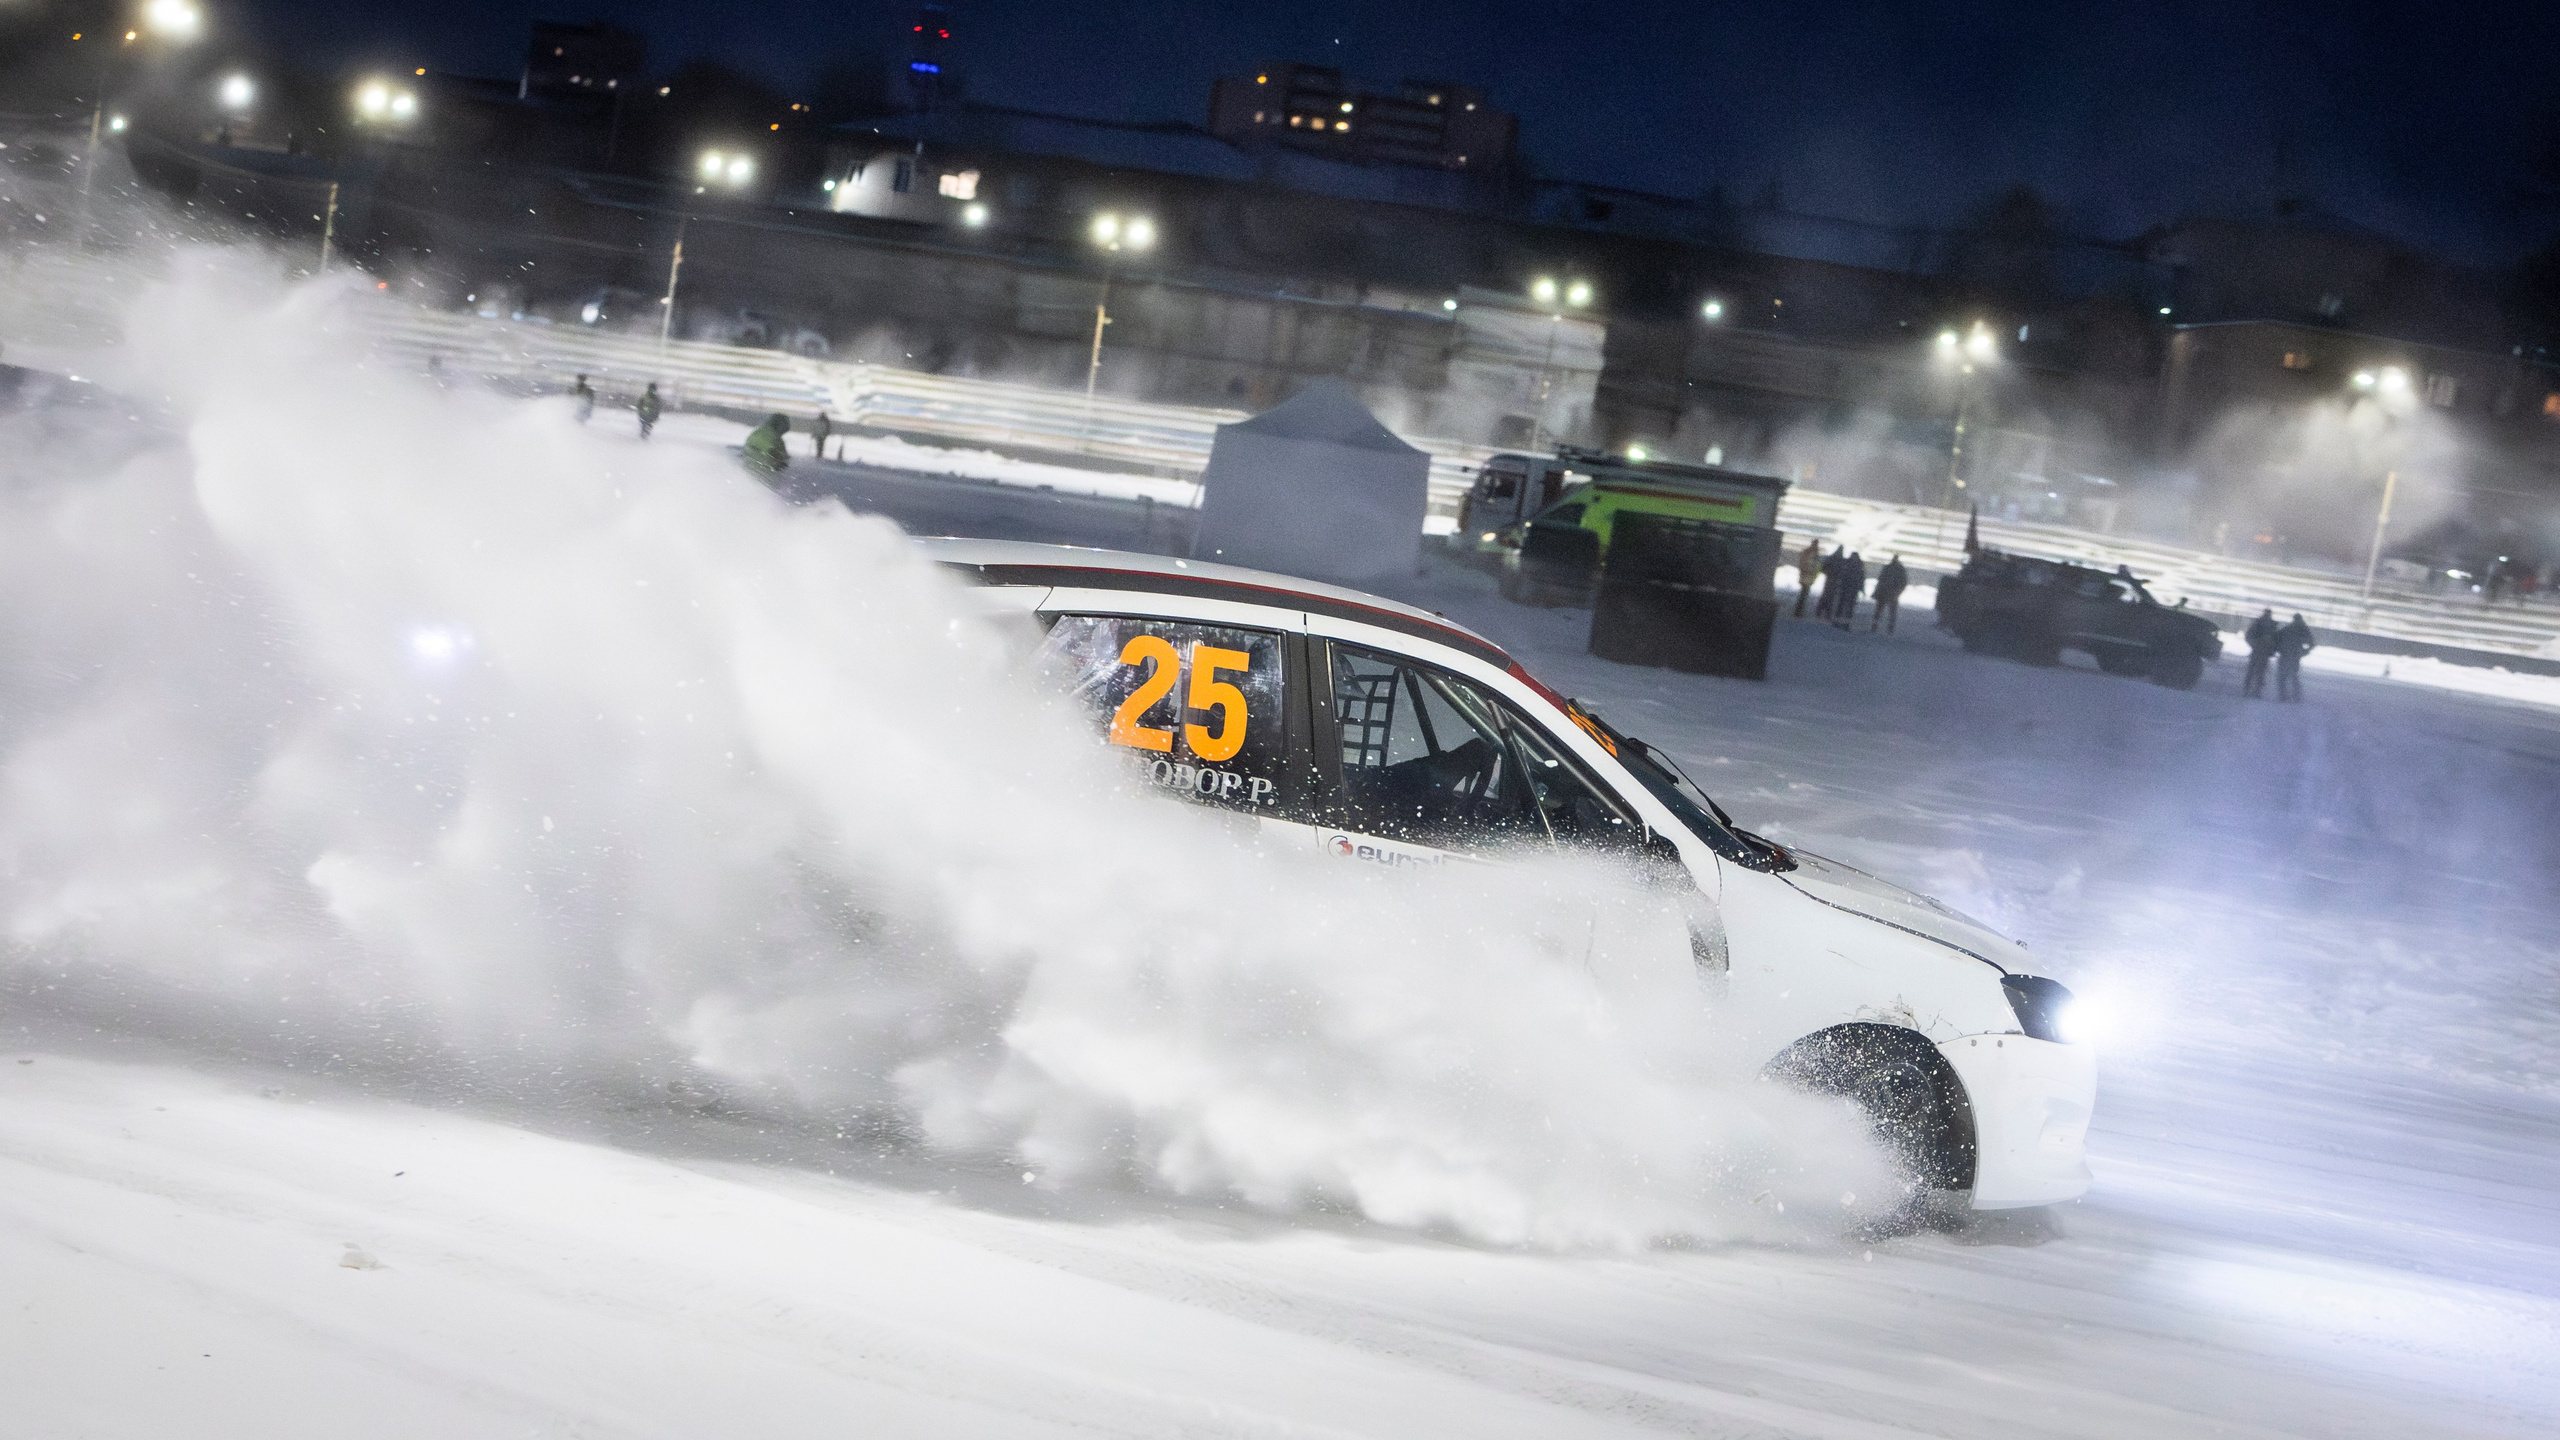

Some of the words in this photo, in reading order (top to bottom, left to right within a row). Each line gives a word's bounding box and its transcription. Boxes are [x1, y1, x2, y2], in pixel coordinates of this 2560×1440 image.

[1109, 635, 1250, 762] 25
[1146, 759, 1243, 799] ОВОР
[1248, 776, 1275, 805] Р.
